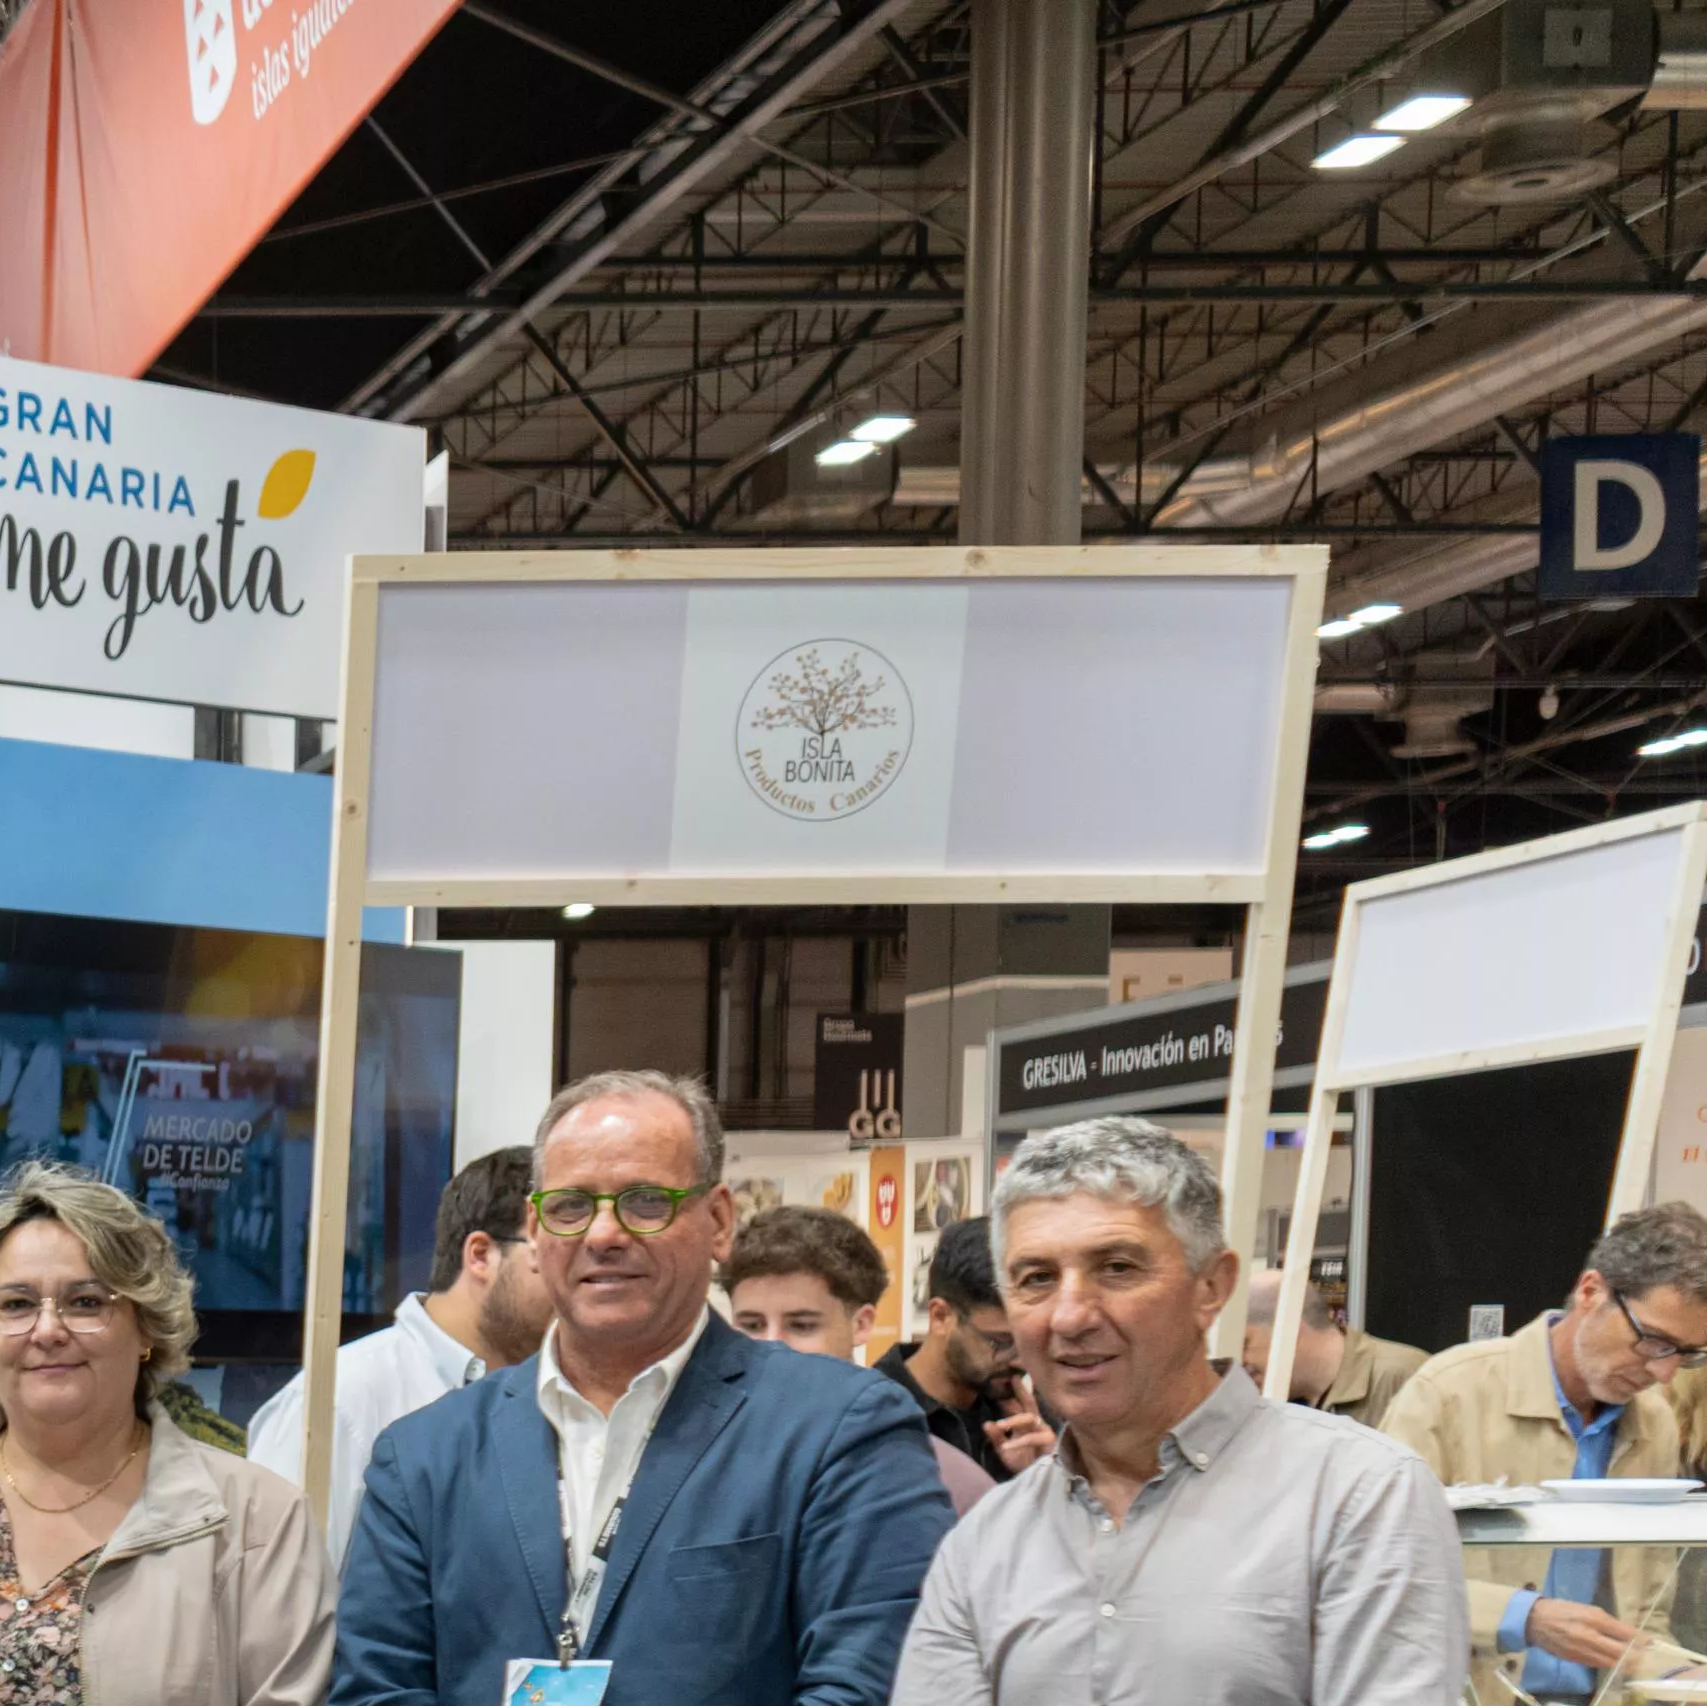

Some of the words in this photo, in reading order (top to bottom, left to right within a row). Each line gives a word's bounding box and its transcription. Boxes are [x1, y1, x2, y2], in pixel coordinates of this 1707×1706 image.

[251, 39, 291, 121] islas
[1573, 460, 1666, 572] D
[102, 478, 305, 661] gusta
[784, 759, 856, 783] BONITA
[801, 737, 843, 760] ISLA
[745, 748, 817, 814] Productos
[828, 749, 901, 812] Canarios
[1022, 1050, 1087, 1091] GRESILVA
[1101, 1030, 1185, 1078] Innovación
[1189, 1034, 1210, 1059] en
[142, 1143, 173, 1170] DE
[178, 1145, 244, 1173] TELDE
[143, 1116, 253, 1144] MERCADO
